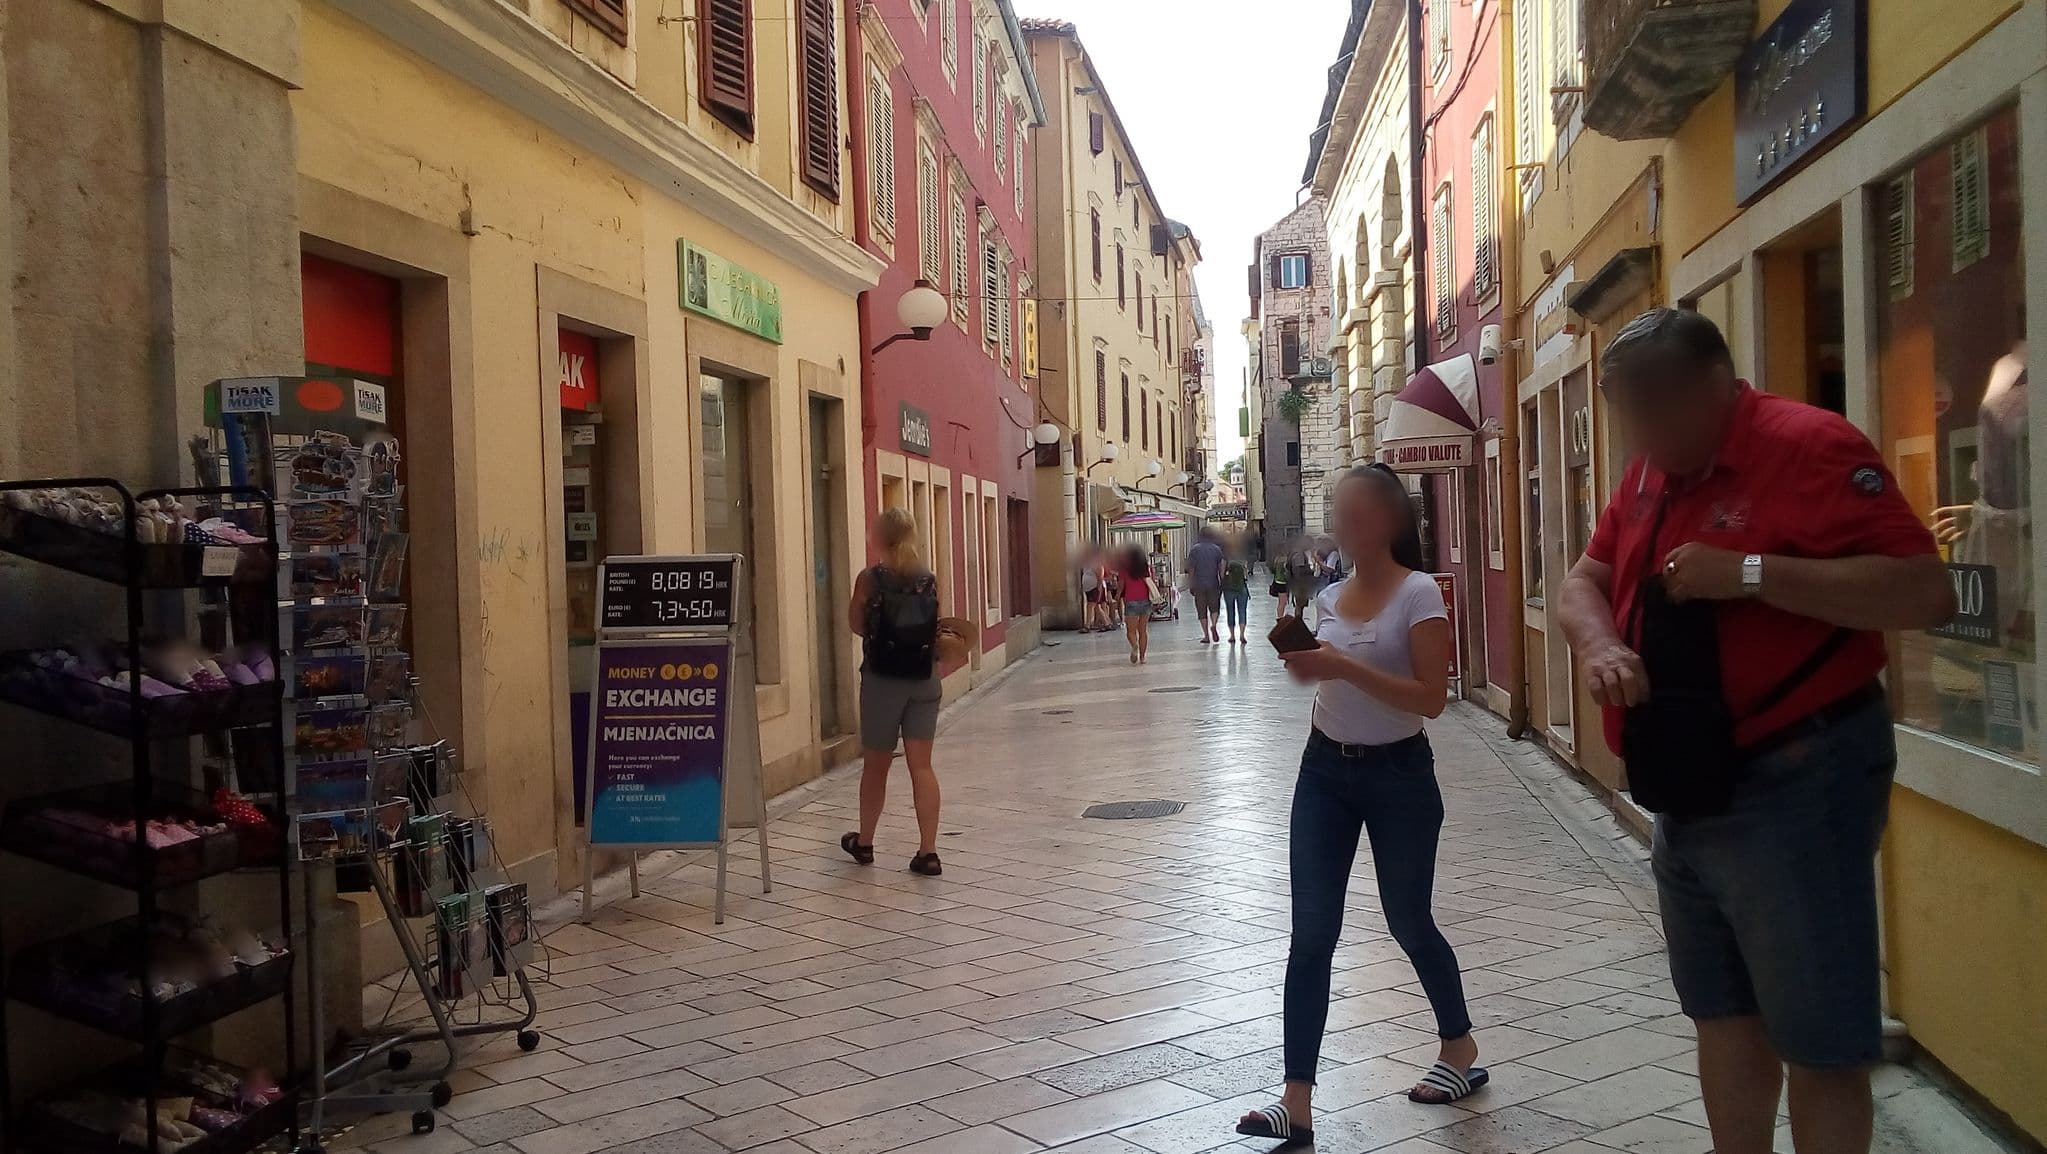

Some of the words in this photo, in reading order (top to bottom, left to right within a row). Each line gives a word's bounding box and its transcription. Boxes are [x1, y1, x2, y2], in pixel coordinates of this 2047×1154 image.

[228, 396, 273, 409] MORE
[359, 399, 384, 414] MORE
[1398, 446, 1427, 463] CAMBIO
[1428, 444, 1461, 461] VALUTE
[651, 600, 713, 621] 7,3450
[608, 667, 656, 679] MONEY
[606, 688, 717, 707] EXCHANGE
[603, 722, 715, 741] MJENJAČNICA
[650, 754, 680, 762] exchange
[616, 773, 635, 781] FAST
